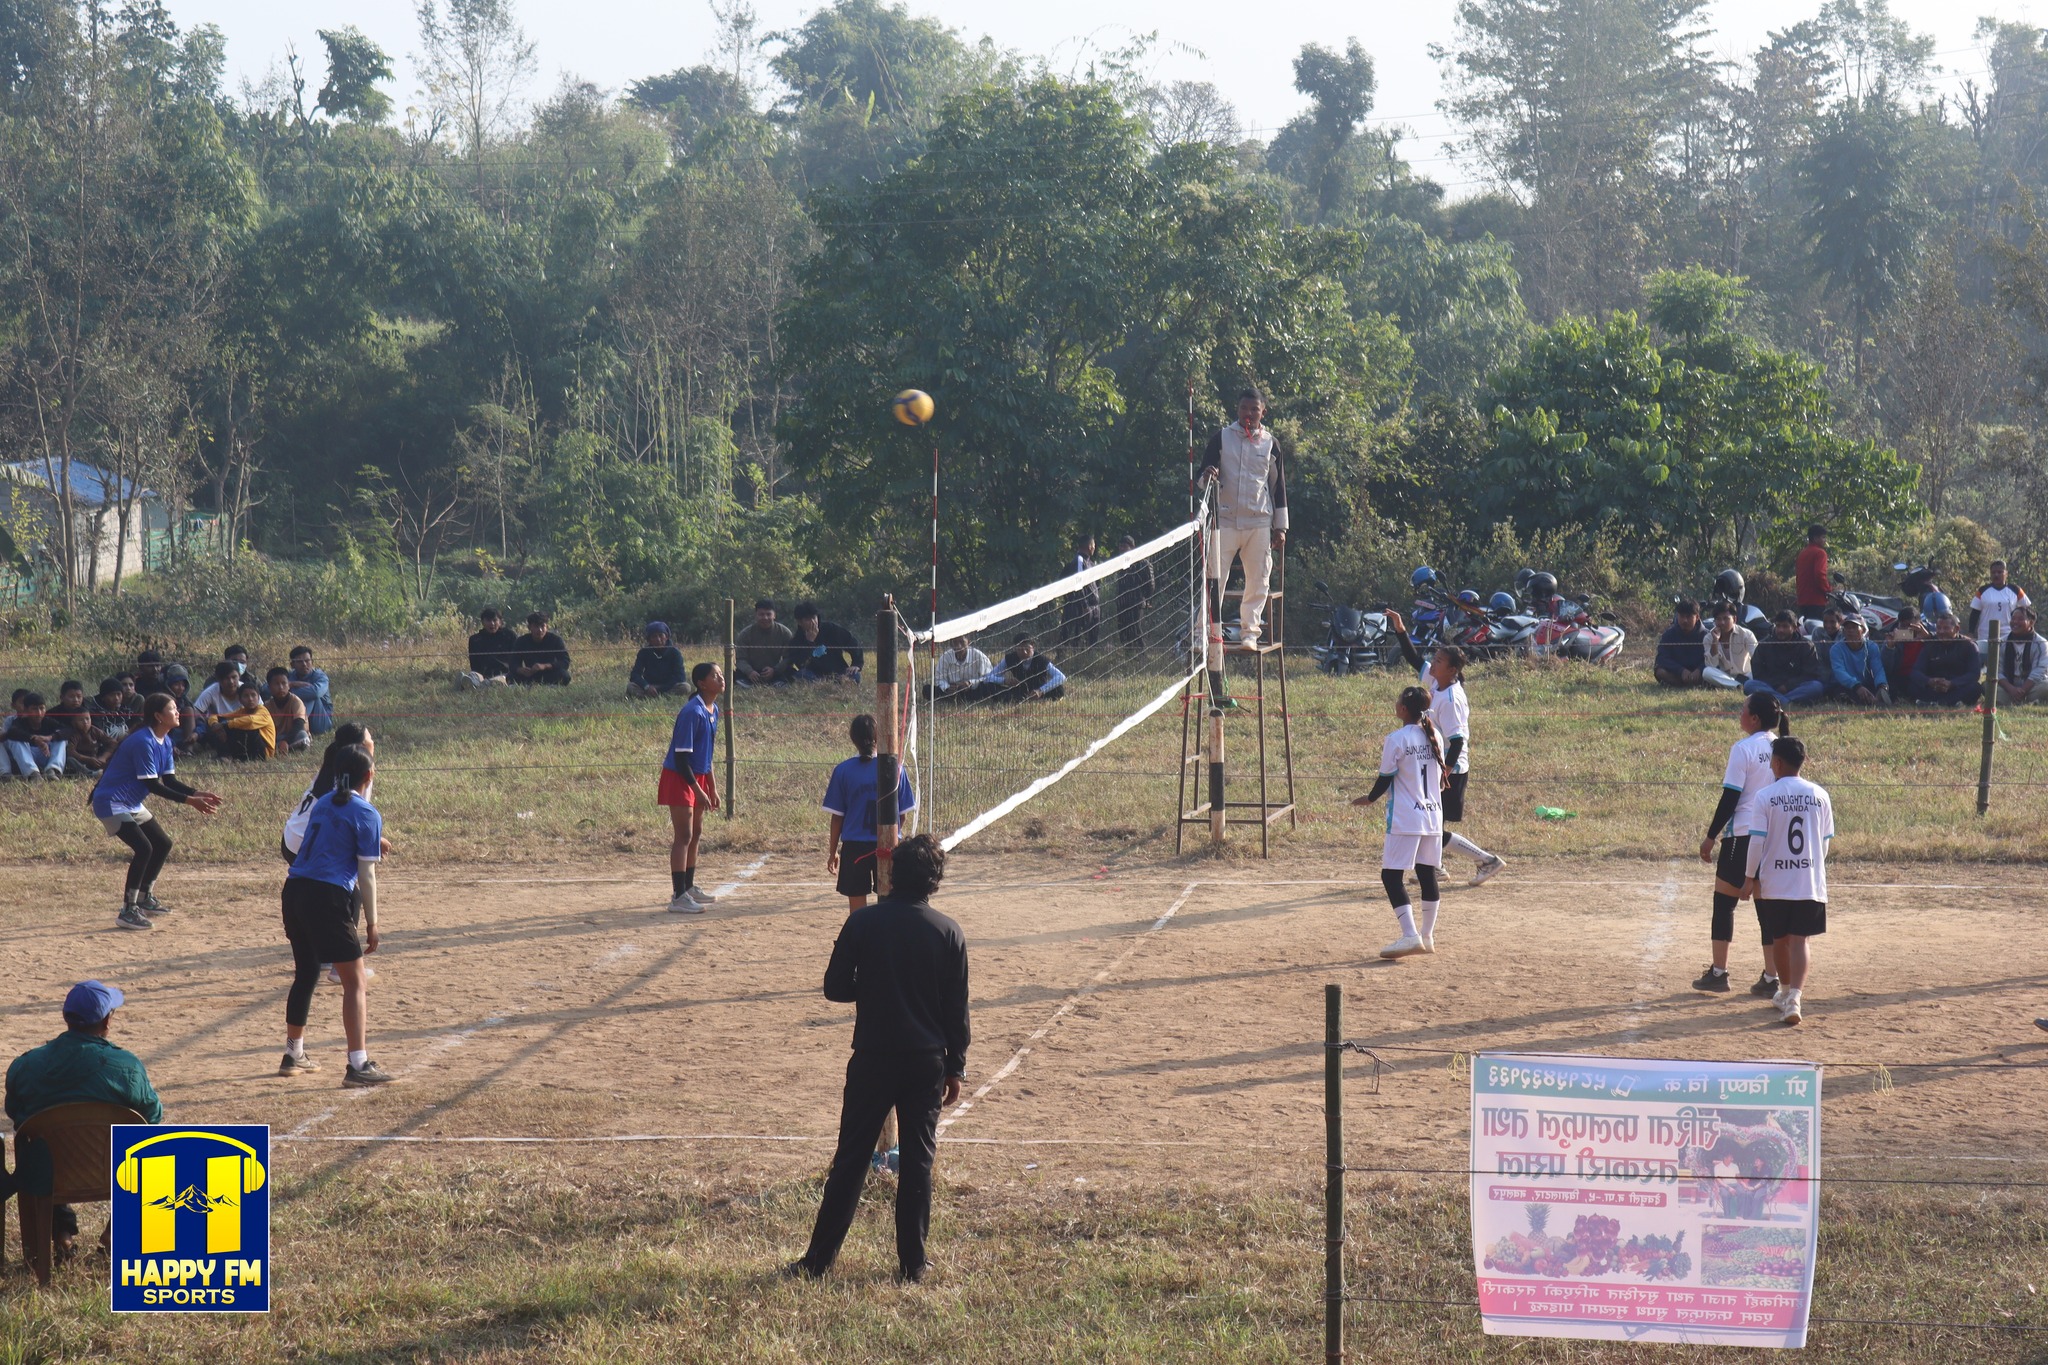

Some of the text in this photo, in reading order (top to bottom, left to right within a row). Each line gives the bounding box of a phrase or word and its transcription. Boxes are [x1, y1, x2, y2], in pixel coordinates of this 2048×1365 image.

[1421, 764, 1428, 799] 1
[1770, 795, 1822, 808] SUNLIGHT CLUB
[303, 822, 322, 861] 7
[1788, 816, 1804, 856] 6
